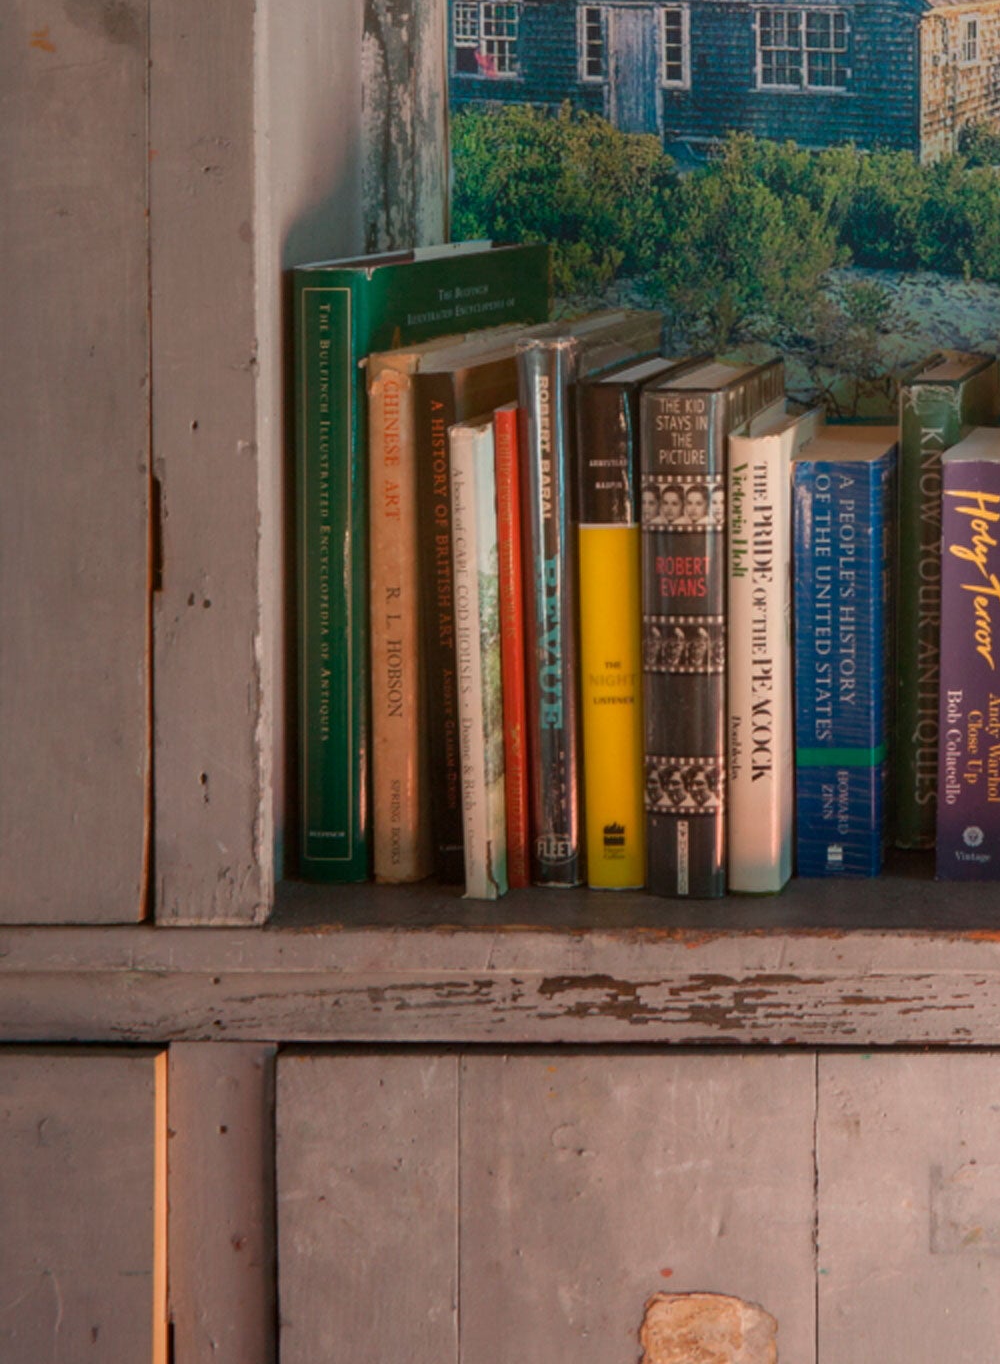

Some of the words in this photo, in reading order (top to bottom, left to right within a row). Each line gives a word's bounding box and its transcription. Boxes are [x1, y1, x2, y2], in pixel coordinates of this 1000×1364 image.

[384, 380, 400, 466] CHINESE
[430, 399, 444, 411] A
[536, 375, 551, 452] ROBERT
[656, 415, 691, 431] STAYS
[694, 415, 708, 431] IN
[659, 398, 681, 413] THE
[685, 398, 705, 413] KID
[431, 418, 447, 497] HISTORY
[659, 449, 706, 465] PICTURE
[671, 432, 692, 448] THE
[453, 468, 463, 477] A
[540, 459, 552, 524] BARAL
[752, 461, 768, 501] THE
[814, 473, 831, 503] OF
[839, 474, 854, 489] A
[918, 426, 945, 527] KNOW
[385, 480, 401, 521] ART
[434, 503, 448, 527] OF
[454, 481, 465, 515] book
[731, 461, 749, 534] Victoria
[455, 517, 466, 532] of
[752, 504, 773, 584] PRIDE
[814, 509, 831, 557] THE
[456, 536, 468, 579] CAPE
[655, 556, 709, 575] ROBERT
[731, 539, 749, 578] Holt
[839, 498, 855, 598] PEOPLE'S
[436, 535, 451, 606] BRITISH
[660, 578, 707, 597] EVANS
[918, 535, 942, 628] YOUR
[386, 586, 401, 604] R.
[457, 584, 470, 621] COD
[752, 587, 768, 612] OF
[814, 565, 832, 655] UNITED
[386, 614, 401, 630] L.
[439, 612, 452, 648] ART
[536, 553, 563, 729] REVUE
[752, 614, 768, 655] THE
[458, 626, 473, 694] HOUSES
[604, 661, 621, 669] THE
[838, 605, 855, 706] HISTORY
[387, 639, 403, 718] HOBSON
[589, 673, 637, 687] NIGHT
[592, 696, 635, 705] LISTENER
[814, 662, 832, 741] STATES
[946, 689, 963, 724] Bob
[462, 717, 473, 759] Doane
[751, 658, 773, 783] PEACOCK
[912, 638, 939, 805] ANTIQUES
[966, 709, 984, 754] Close
[463, 764, 473, 776] &
[944, 728, 962, 805] Colacello
[963, 759, 983, 784] Up
[391, 780, 401, 823] SPRING
[464, 779, 476, 811] Rich
[821, 784, 834, 820] ZINN
[836, 770, 850, 835] HOWARD
[391, 827, 402, 866] BOOKS
[537, 840, 572, 857] FLEET
[954, 849, 992, 863] Vintage
